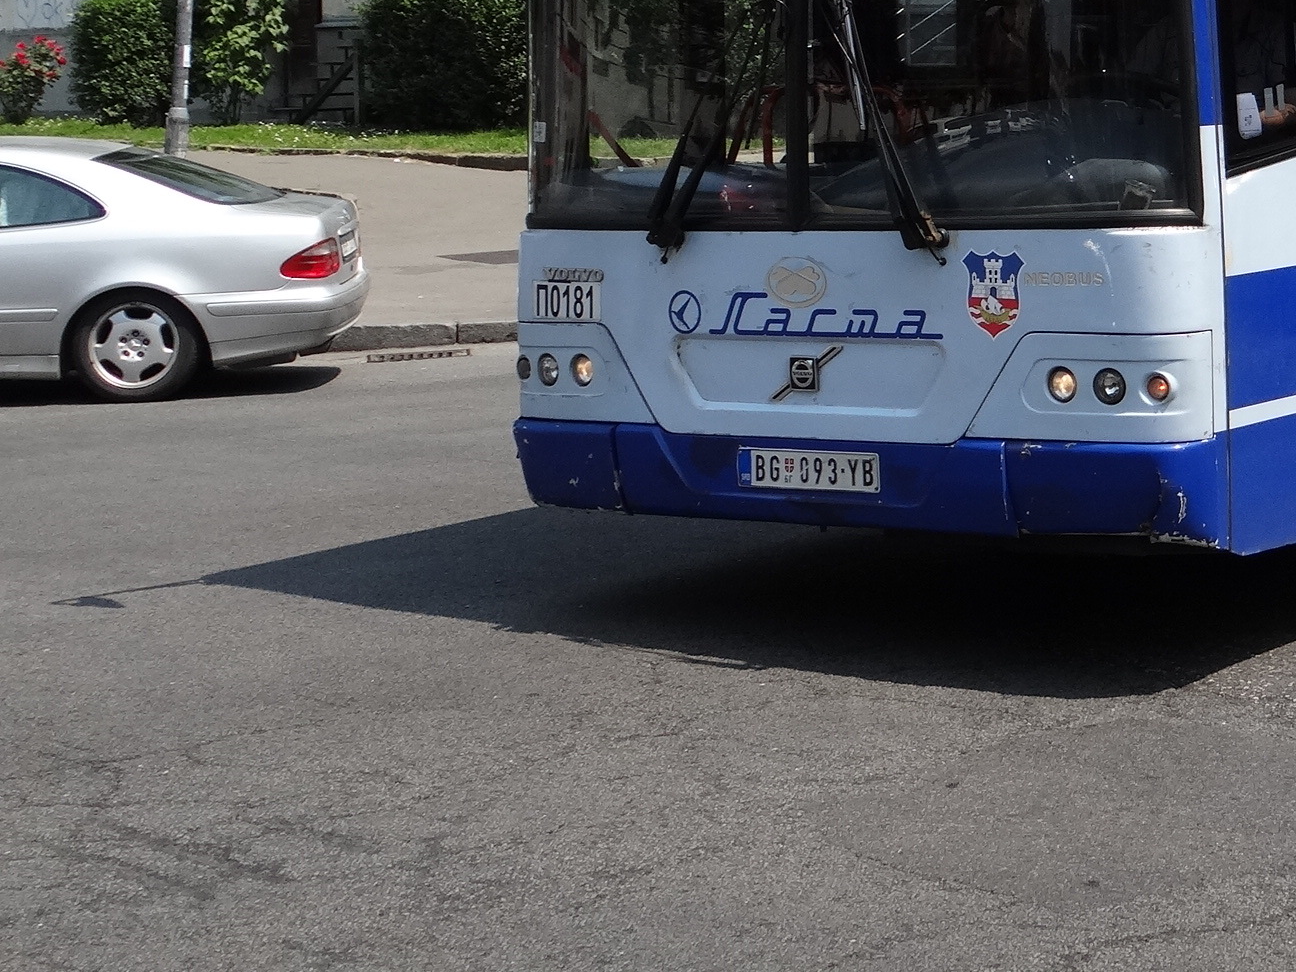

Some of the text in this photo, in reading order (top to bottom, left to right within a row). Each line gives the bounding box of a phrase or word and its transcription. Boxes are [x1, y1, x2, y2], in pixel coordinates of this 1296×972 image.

[543, 267, 604, 282] VOLVO
[1023, 271, 1105, 287] NEOBUS
[755, 454, 780, 482] BG
